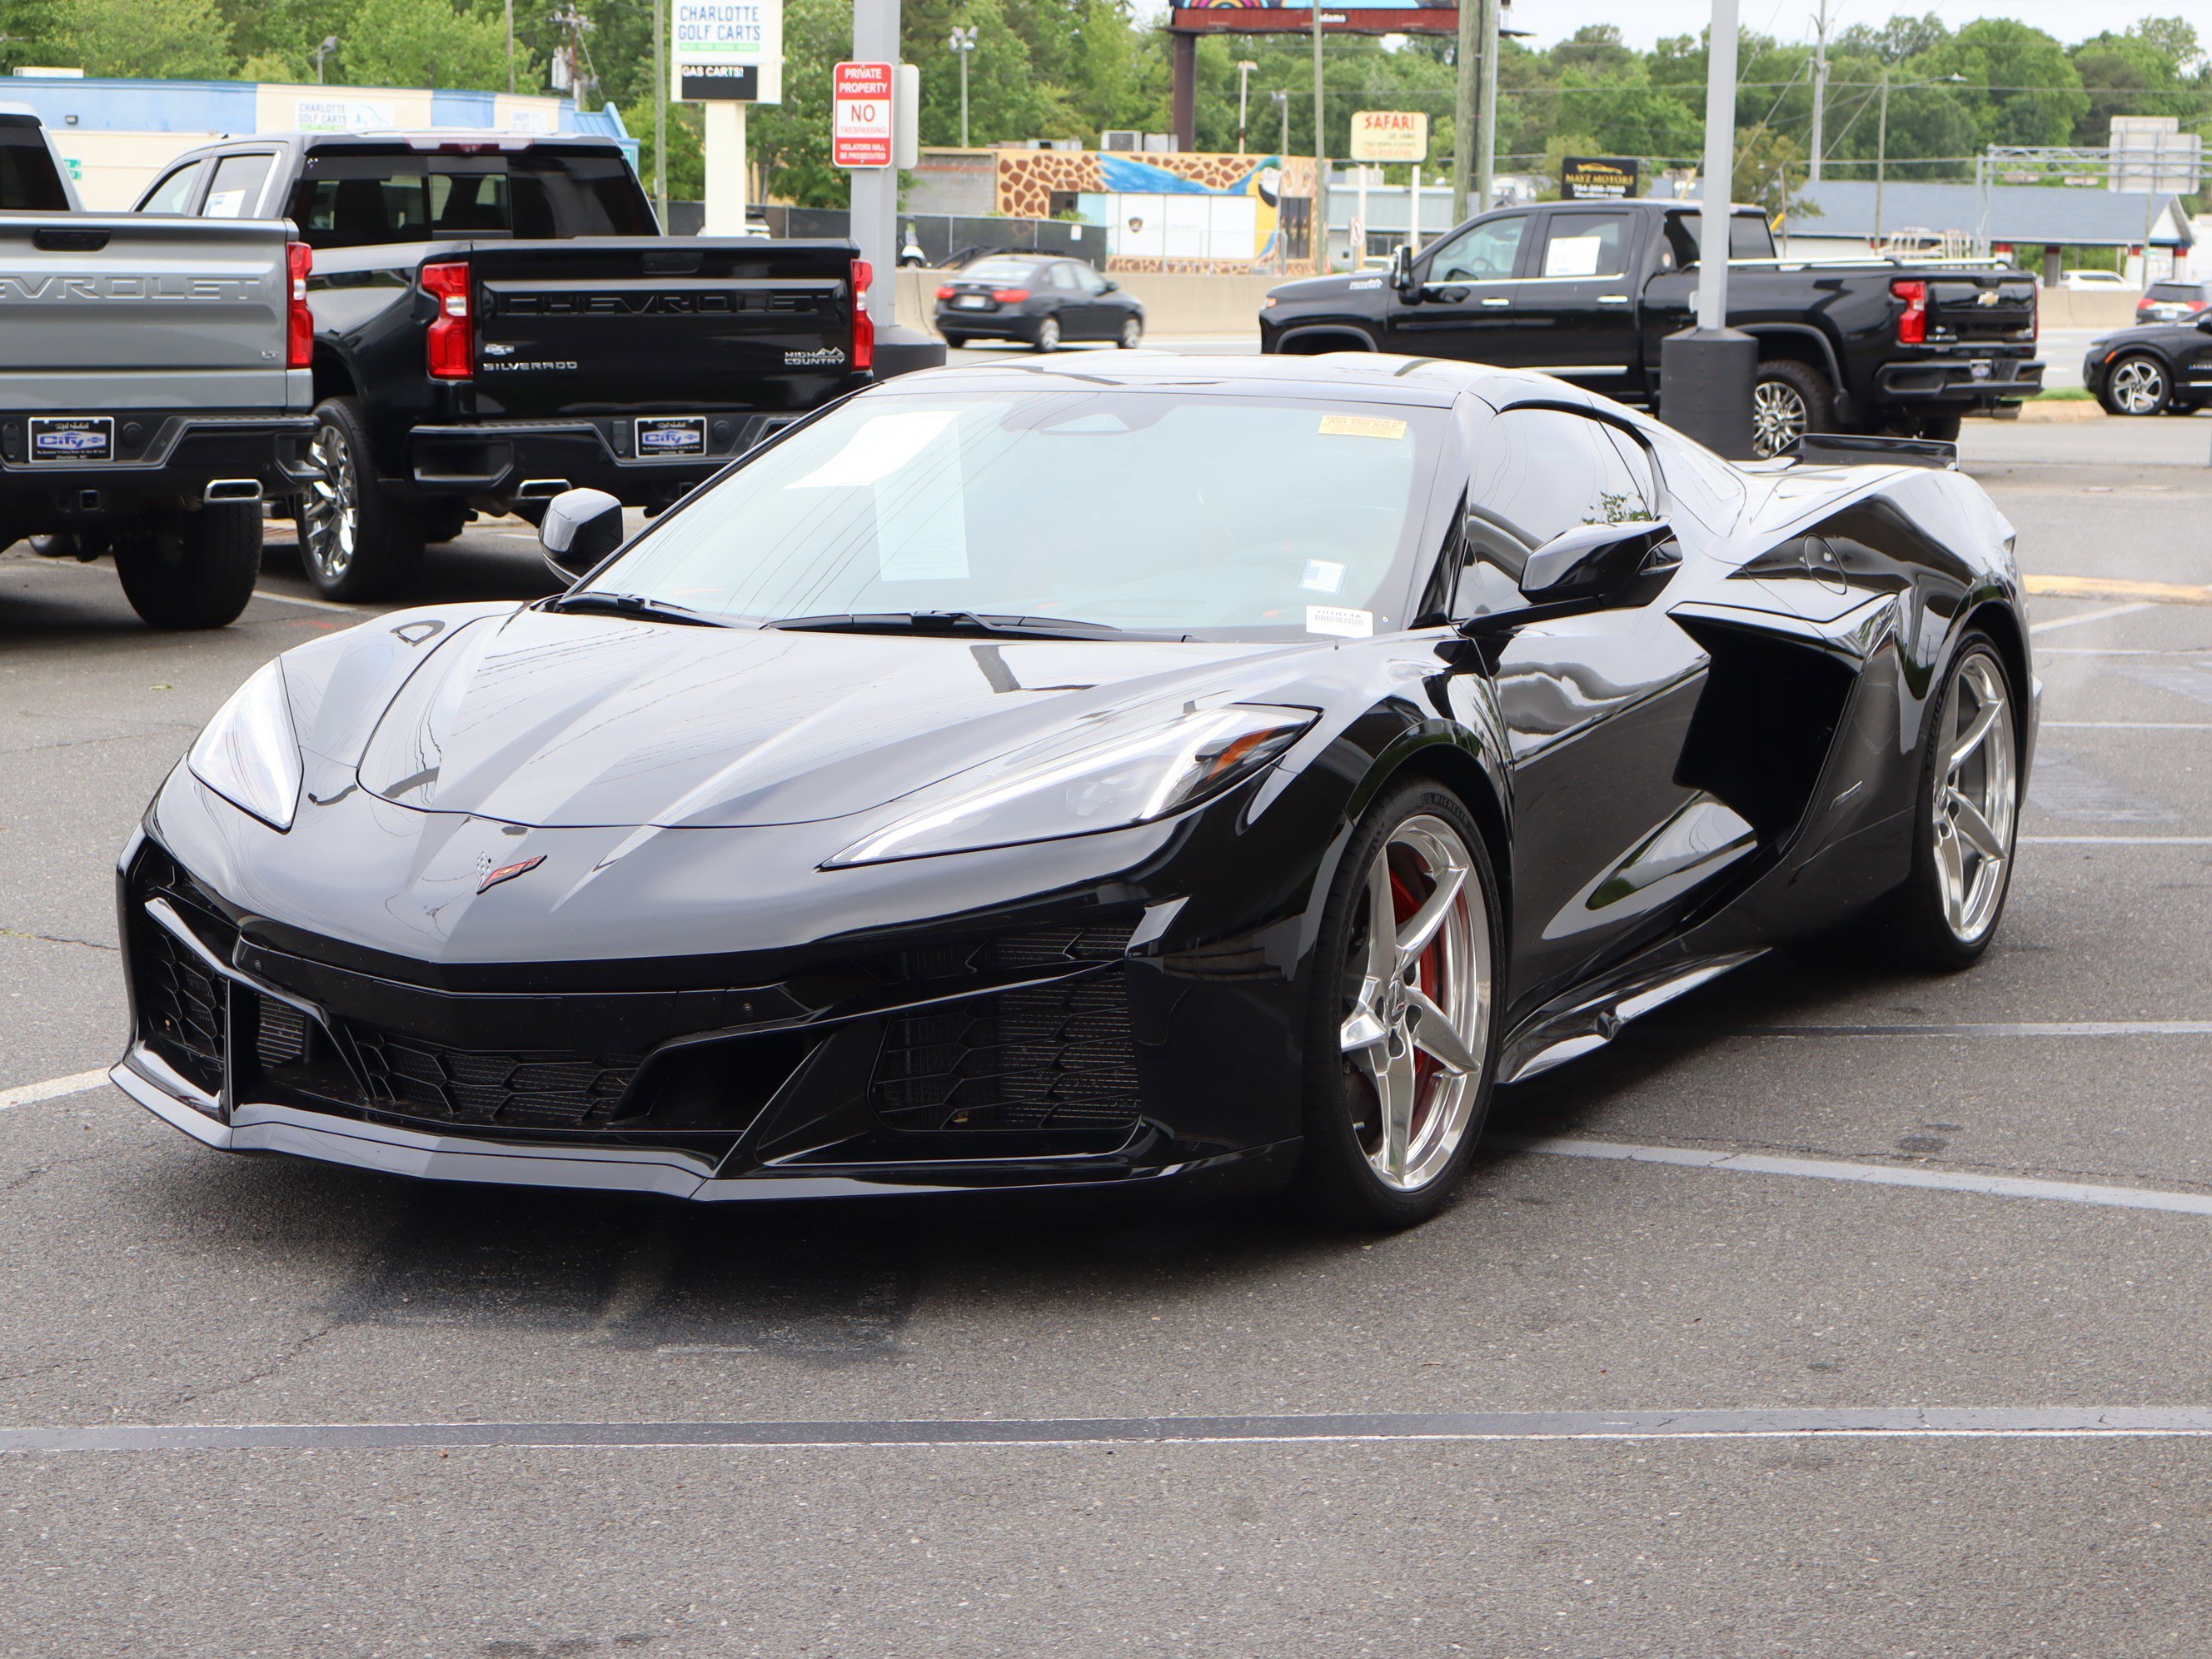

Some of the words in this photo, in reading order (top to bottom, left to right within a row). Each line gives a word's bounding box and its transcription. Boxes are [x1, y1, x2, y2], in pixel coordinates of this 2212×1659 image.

[680, 6, 760, 22] CHARLOTTE
[678, 24, 711, 40] GOLF
[717, 24, 760, 40] CARTS
[681, 66, 705, 77] GAS
[844, 67, 882, 79] PRIVATE
[839, 82, 888, 93] PROPERTY
[299, 102, 346, 112] CHARLOTTE
[851, 104, 875, 122] NO
[321, 114, 347, 123] CARTS
[1363, 114, 1415, 130] SAFARI
[840, 126, 887, 134] TRESPASSING
[1565, 173, 1592, 183] MAYZ
[1592, 175, 1634, 186] MOTORS
[504, 293, 830, 315] CHEVROLET
[261, 350, 279, 361] LT
[482, 361, 579, 371] SILVERADO
[39, 434, 85, 448] City
[645, 432, 682, 446] City
[1432, 793, 1470, 825] MICHELIN
